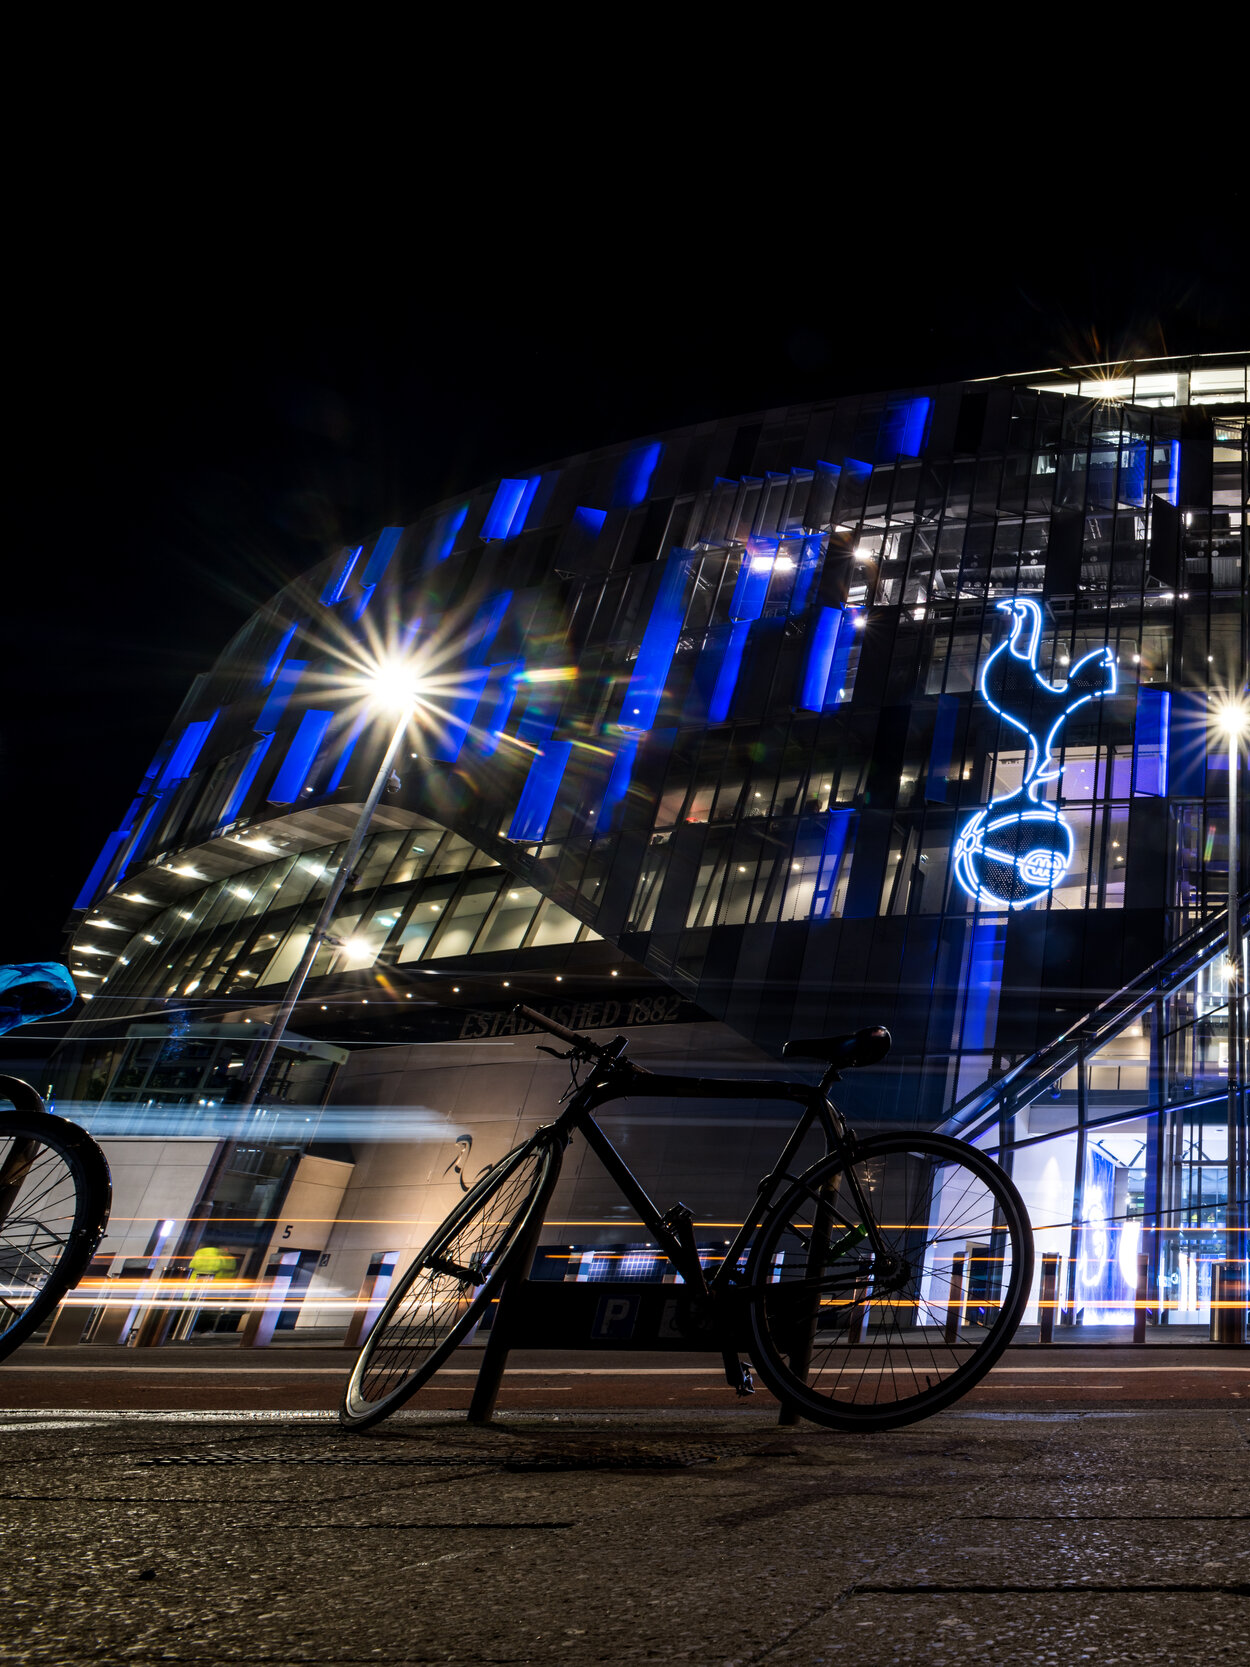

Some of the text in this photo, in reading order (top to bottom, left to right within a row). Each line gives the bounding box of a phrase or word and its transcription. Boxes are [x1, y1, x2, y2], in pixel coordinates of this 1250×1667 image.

[458, 994, 681, 1040] ESTABISHED 1882
[282, 1225, 293, 1239] 5
[600, 1298, 631, 1335] P
